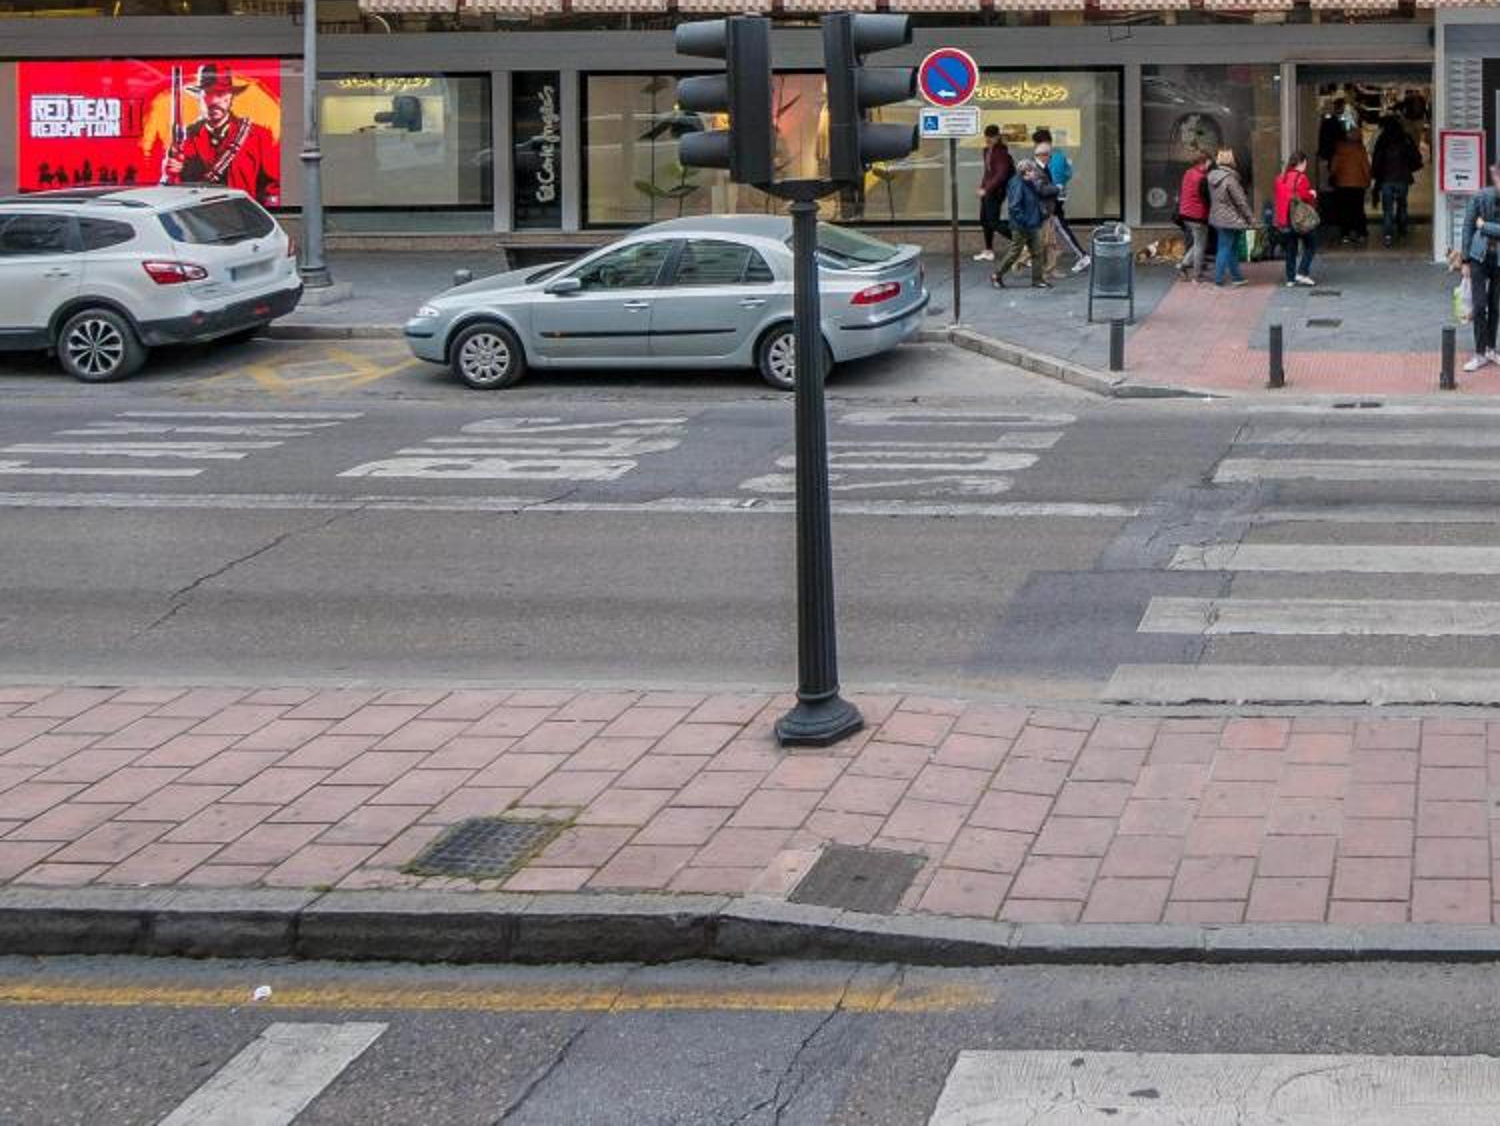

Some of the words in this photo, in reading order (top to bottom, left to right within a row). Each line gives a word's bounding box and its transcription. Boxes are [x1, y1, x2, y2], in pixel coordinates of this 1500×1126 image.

[31, 98, 70, 121] RED
[70, 97, 121, 121] DEAD
[535, 84, 561, 143] Inglés
[31, 120, 121, 138] REDEMPTION
[536, 143, 555, 184] Corte
[535, 184, 555, 203] El
[335, 416, 690, 482] BUS
